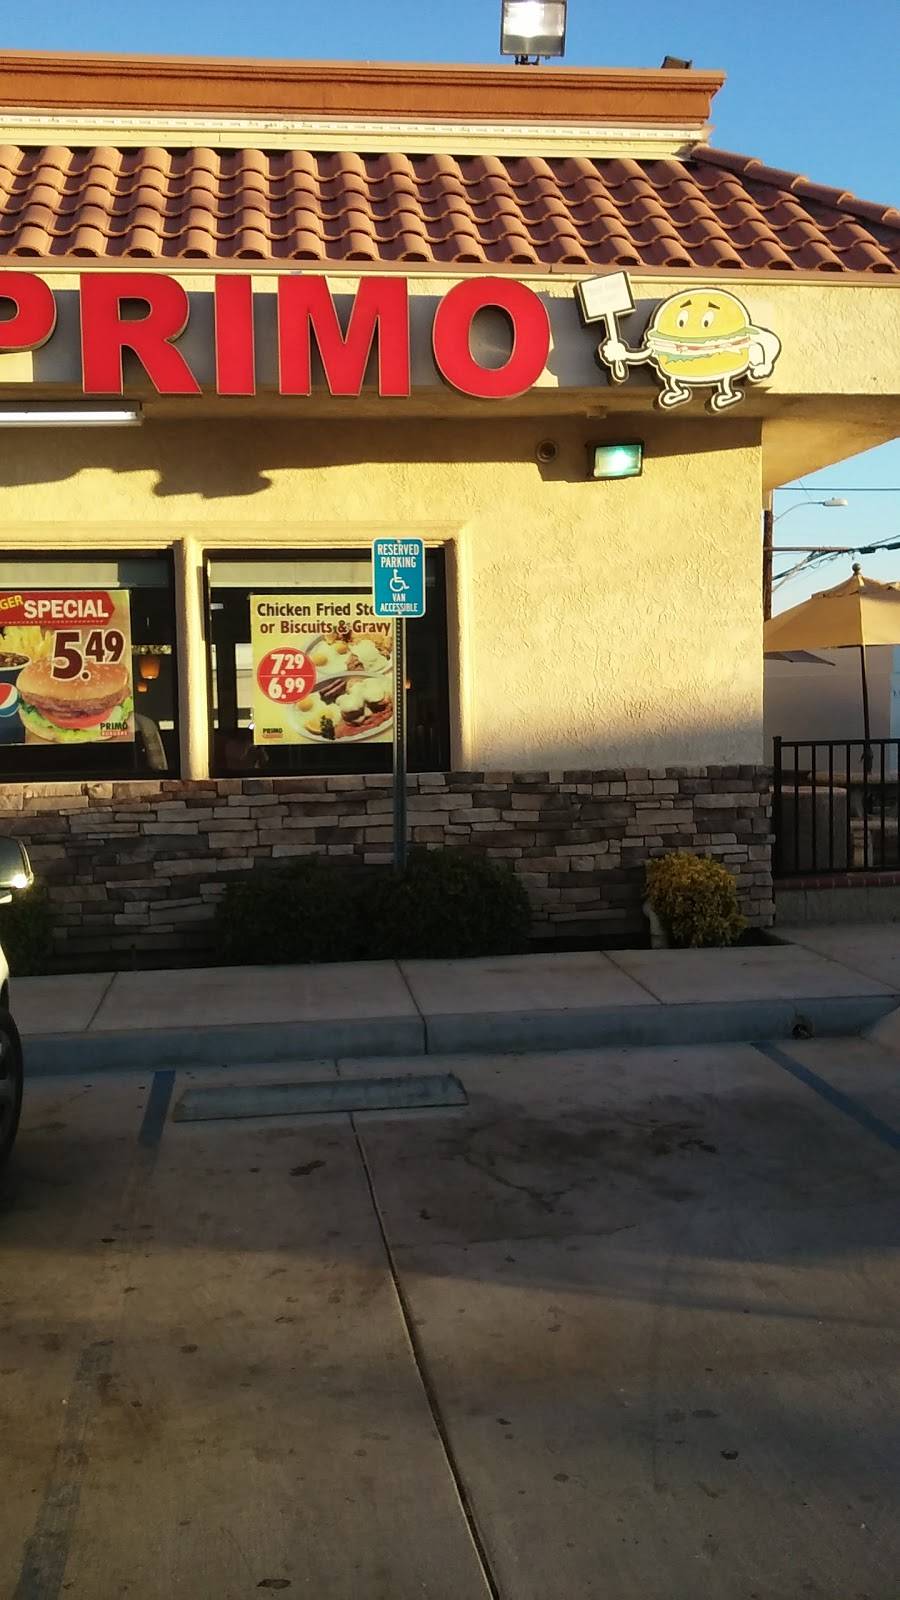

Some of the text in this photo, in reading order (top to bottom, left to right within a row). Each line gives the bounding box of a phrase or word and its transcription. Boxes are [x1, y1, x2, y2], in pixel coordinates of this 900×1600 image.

[377, 543, 420, 556] RESERVED
[380, 556, 417, 568] PARKING
[392, 593, 407, 602] VAN
[23, 599, 109, 619] SPECIAL
[257, 602, 311, 617] Chicken
[316, 602, 351, 617] Fried
[379, 602, 419, 612] ACCESSIBLE
[260, 620, 391, 637] or Biscuits & Gravy
[51, 629, 125, 681] 5.49
[270, 653, 305, 675] 7.29
[268, 677, 306, 699] 6.99
[100, 721, 129, 730] PRIMO
